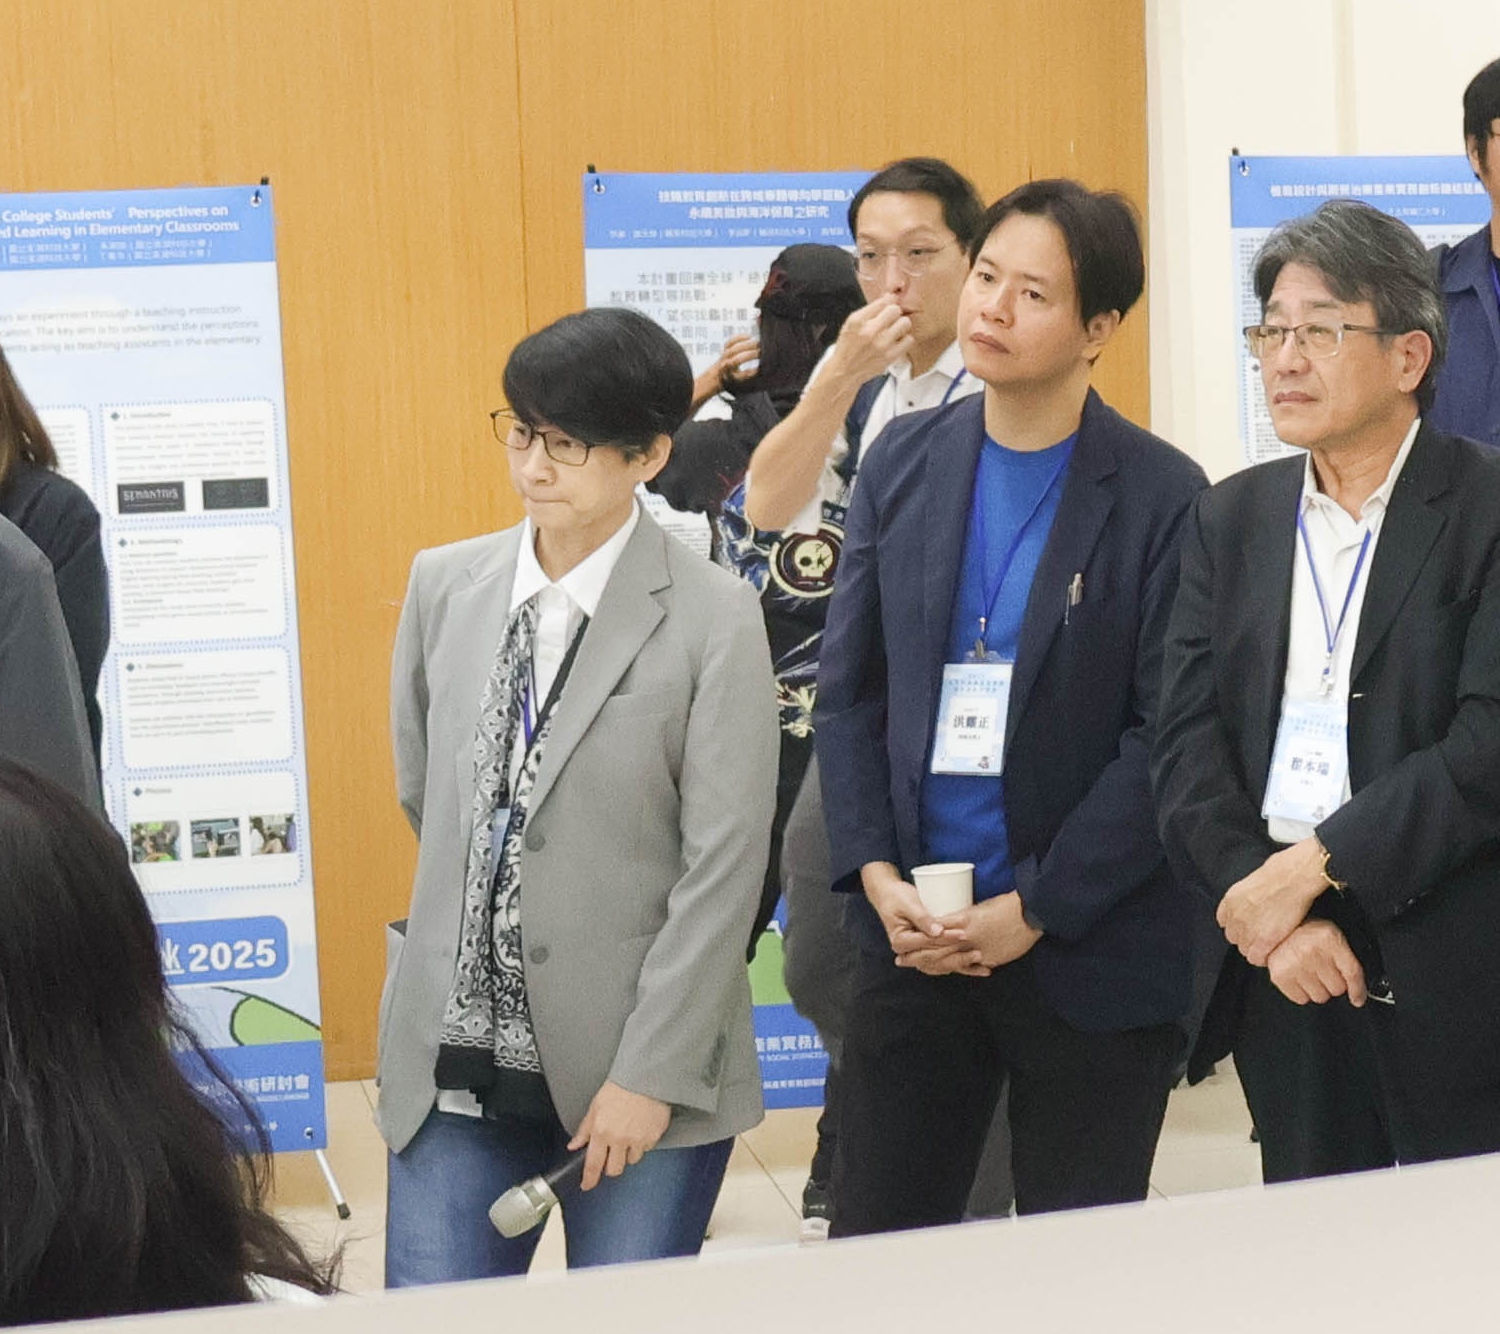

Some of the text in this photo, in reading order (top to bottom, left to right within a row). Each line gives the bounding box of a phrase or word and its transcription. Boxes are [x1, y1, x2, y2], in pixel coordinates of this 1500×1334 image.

[2, 209, 51, 225] College
[127, 205, 209, 221] Perspectives
[211, 206, 229, 217] on
[14, 224, 71, 240] Learning
[74, 224, 87, 236] in
[89, 222, 163, 238] Elementary
[165, 220, 240, 234] Classrooms
[32, 310, 87, 322] experiment
[90, 308, 132, 320] through
[142, 306, 187, 318] teaching
[36, 327, 54, 336] The
[57, 326, 74, 338] key
[122, 322, 180, 334] understand
[182, 321, 198, 331] the
[200, 320, 260, 333] perceptions
[30, 342, 61, 355] acting
[77, 339, 120, 353] teaching
[185, 337, 202, 347] the
[203, 335, 261, 348] elementary
[189, 938, 277, 973] 2025
